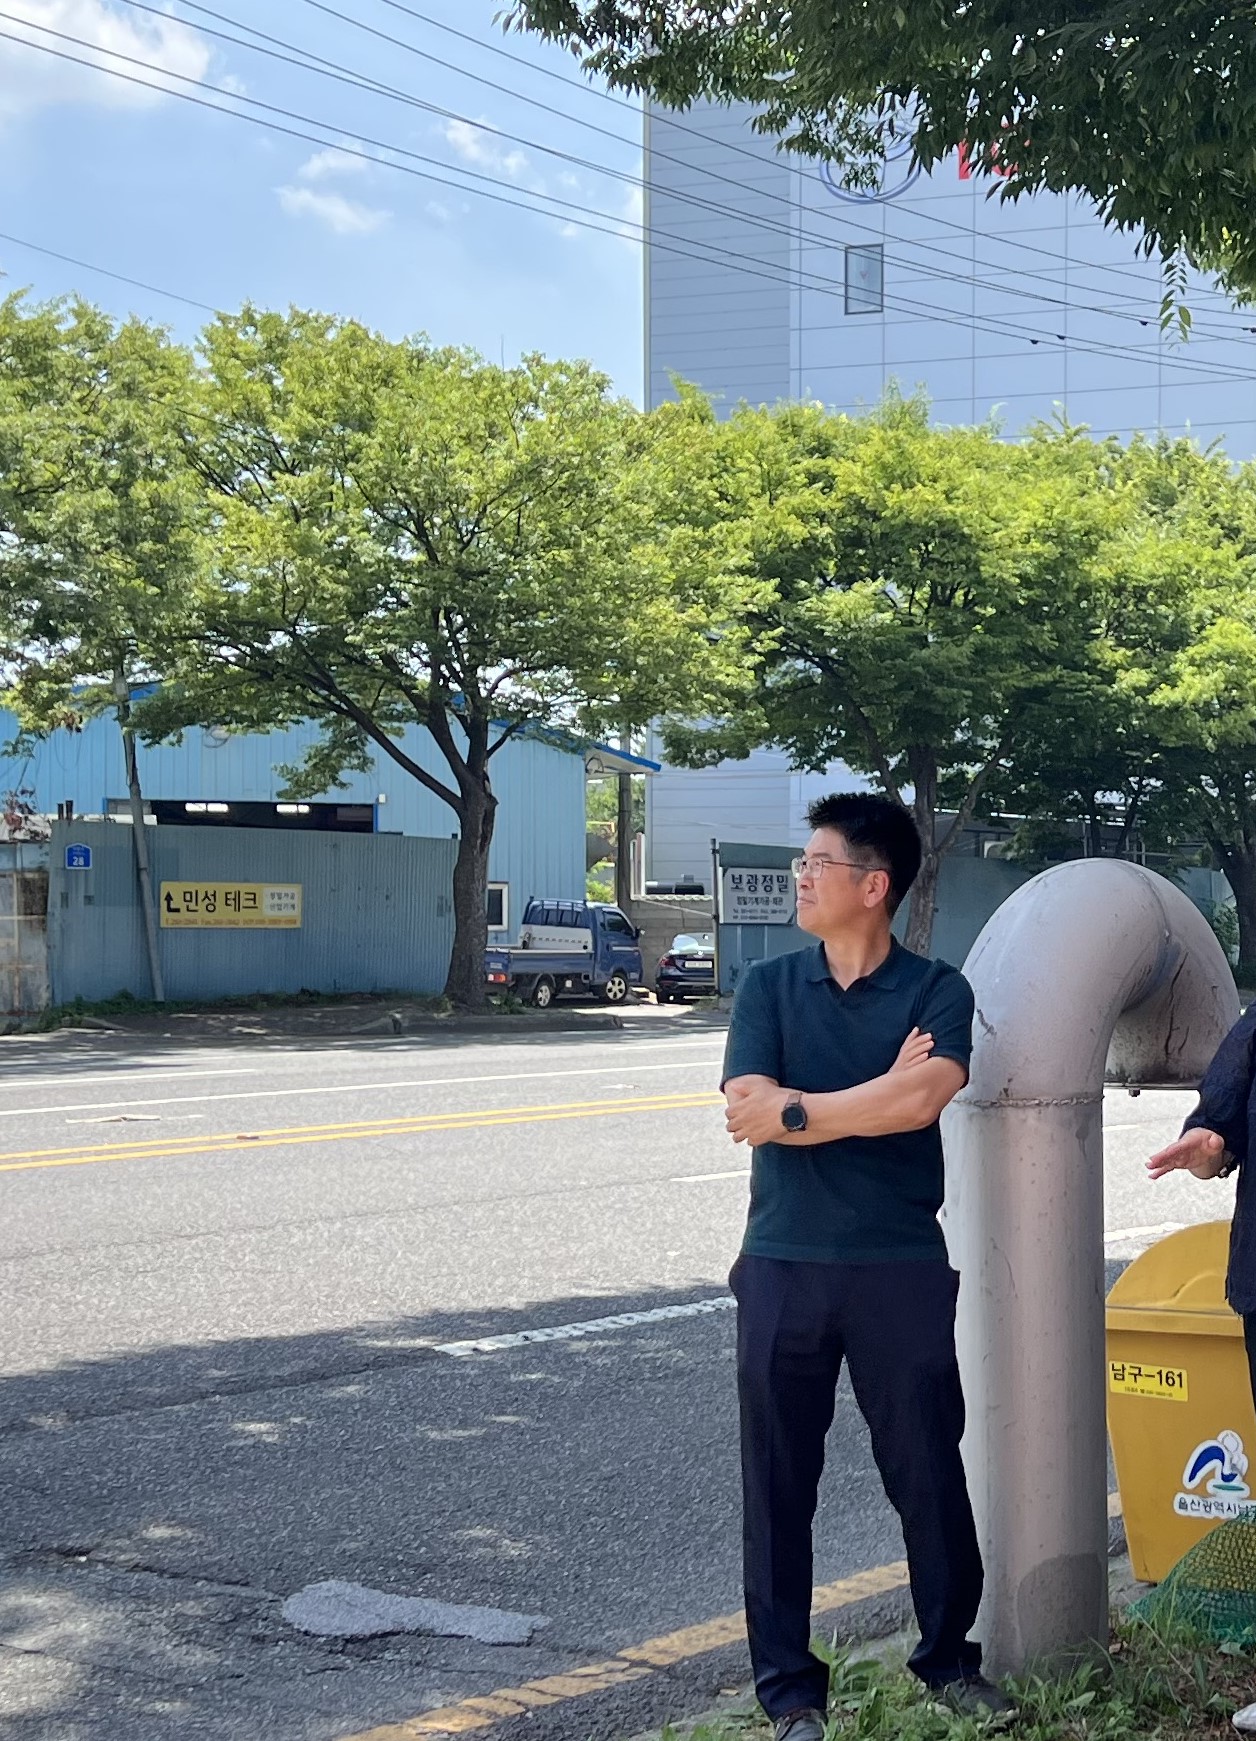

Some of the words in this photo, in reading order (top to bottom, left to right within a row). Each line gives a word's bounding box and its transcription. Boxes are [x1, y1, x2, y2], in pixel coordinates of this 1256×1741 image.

[730, 873, 789, 893] 보광정밀
[183, 889, 217, 913] 민성
[224, 889, 259, 913] 테크
[1111, 1362, 1184, 1389] 남구-161
